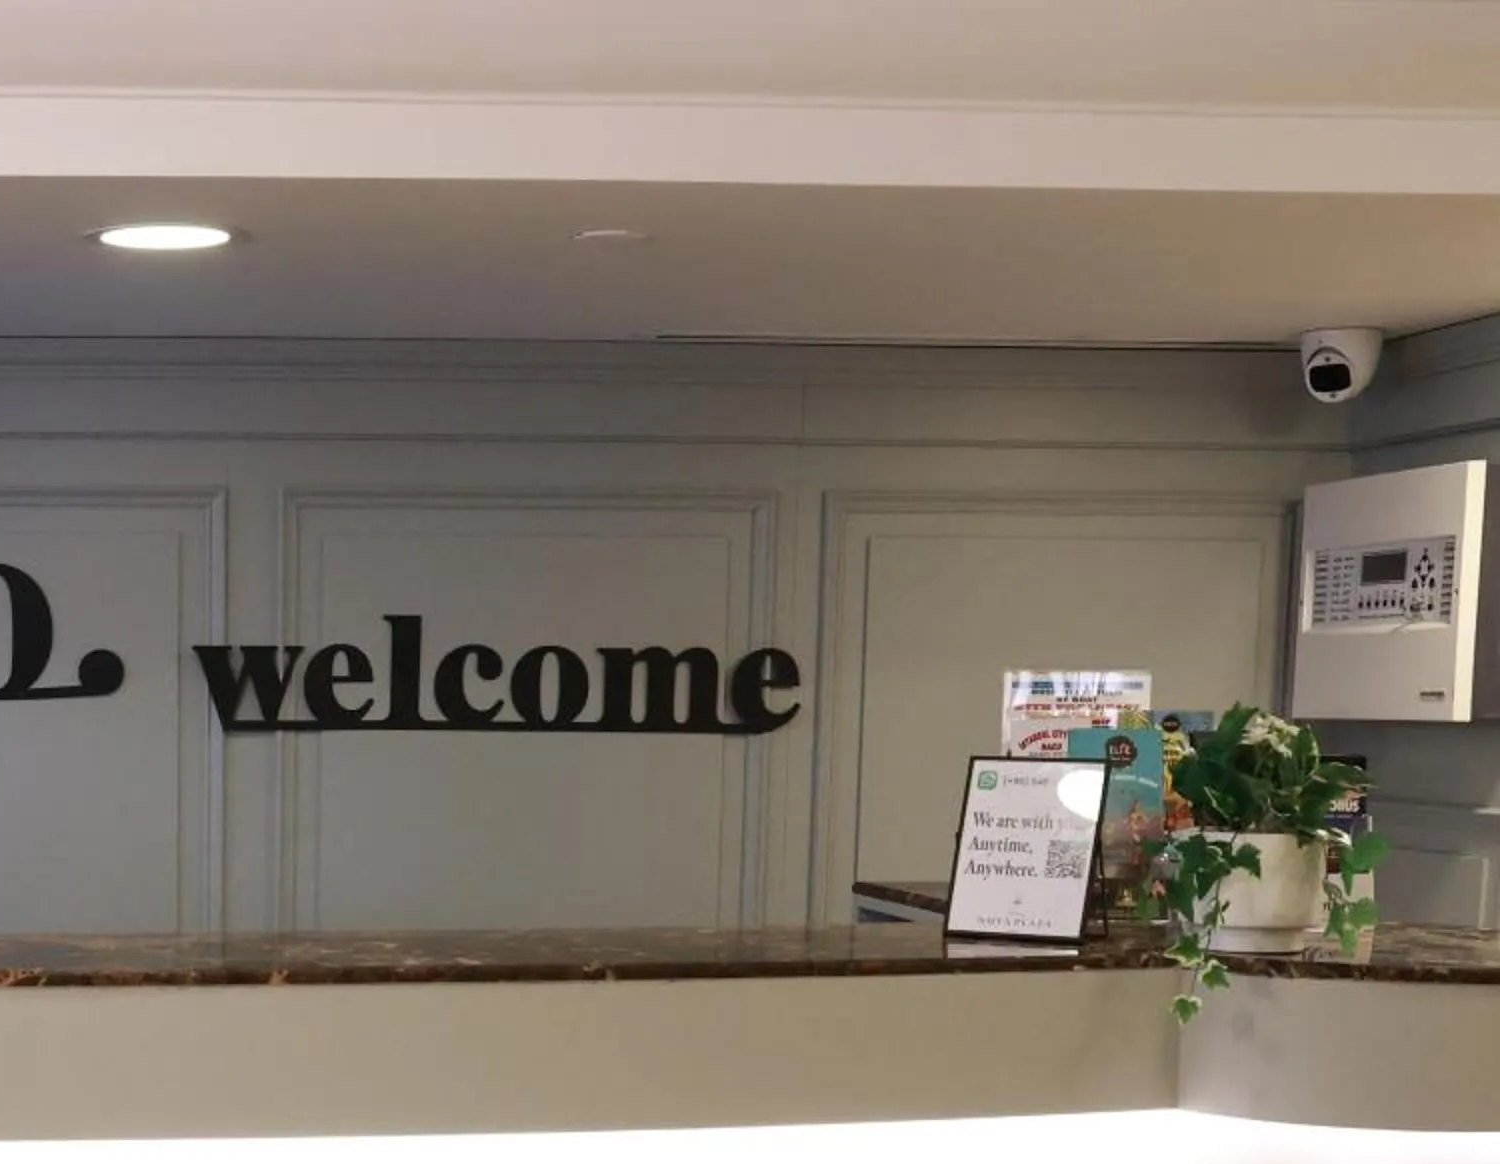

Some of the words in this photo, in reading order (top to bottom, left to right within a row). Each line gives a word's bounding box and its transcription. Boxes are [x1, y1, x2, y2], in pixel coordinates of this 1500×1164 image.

[193, 614, 803, 736] welcome
[973, 812, 993, 828] We
[995, 815, 1019, 829] are
[1021, 814, 1053, 831] with
[970, 836, 1033, 856] Anytime,
[964, 860, 1038, 880] Anywhere.
